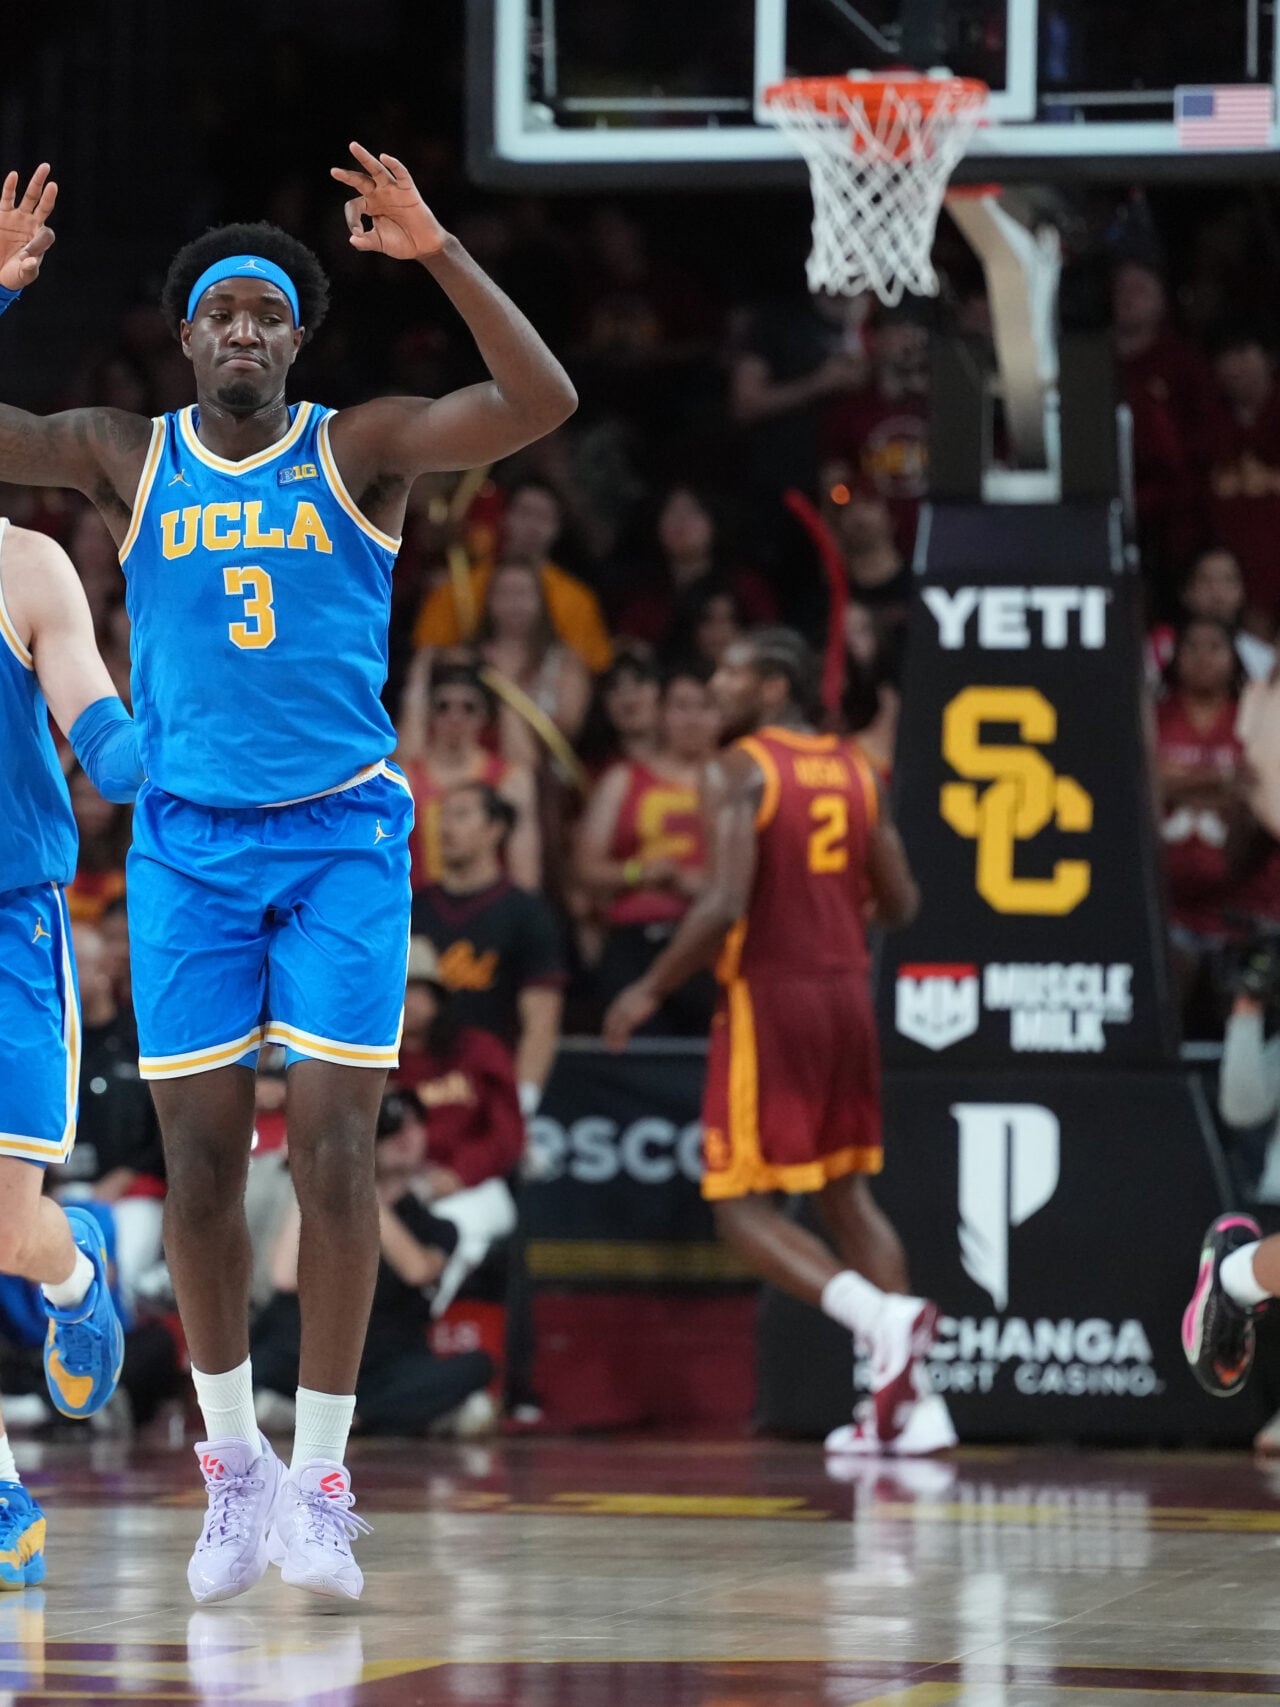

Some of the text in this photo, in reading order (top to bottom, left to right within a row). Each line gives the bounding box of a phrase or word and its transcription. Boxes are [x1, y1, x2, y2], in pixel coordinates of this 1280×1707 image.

[160, 500, 334, 561] UCLA
[223, 565, 277, 650] 3
[922, 585, 1106, 650] YETI
[808, 794, 848, 874] 2
[983, 961, 1134, 1011] MUSCLE
[1010, 1007, 1106, 1053] MILK
